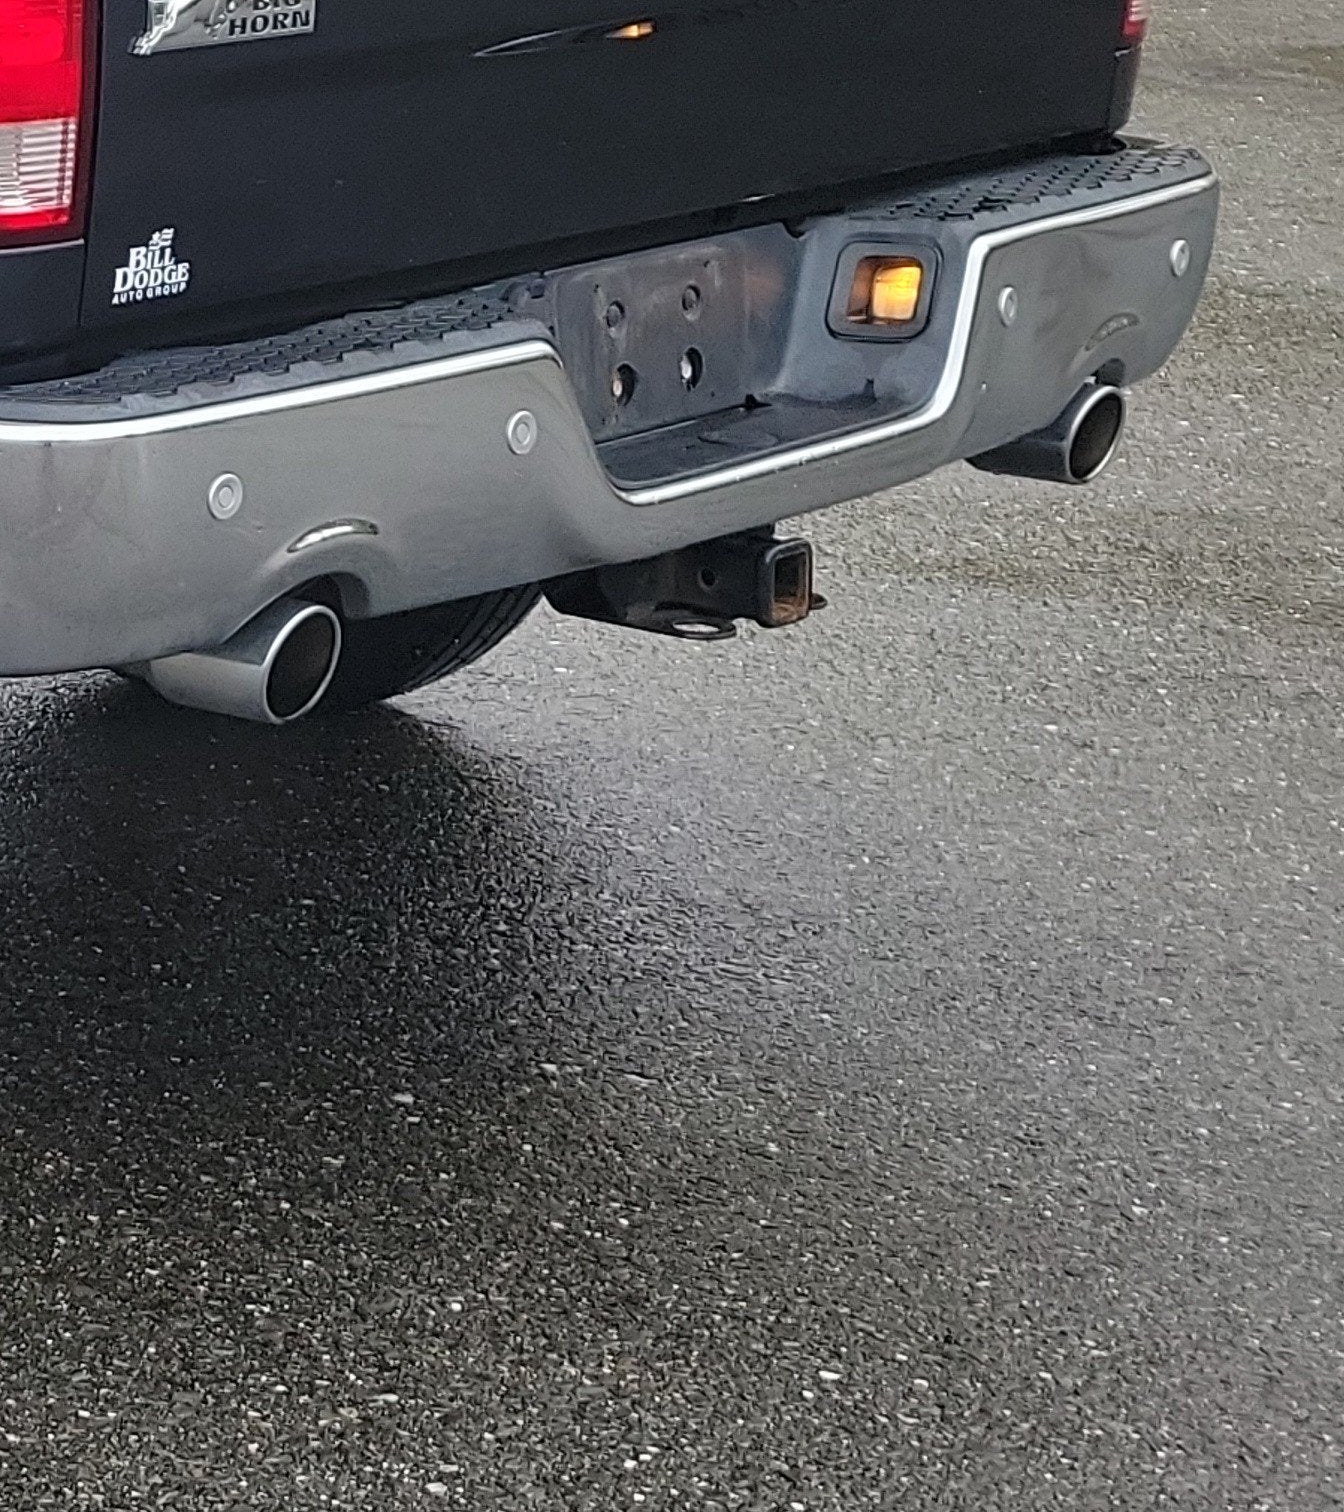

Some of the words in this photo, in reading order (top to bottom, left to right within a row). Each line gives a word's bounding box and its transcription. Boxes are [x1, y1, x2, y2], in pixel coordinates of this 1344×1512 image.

[228, 9, 312, 37] HORN
[129, 245, 175, 272] BILL
[113, 262, 190, 293] DODGE
[111, 289, 144, 305] AUTO
[145, 281, 188, 299] GROUP
